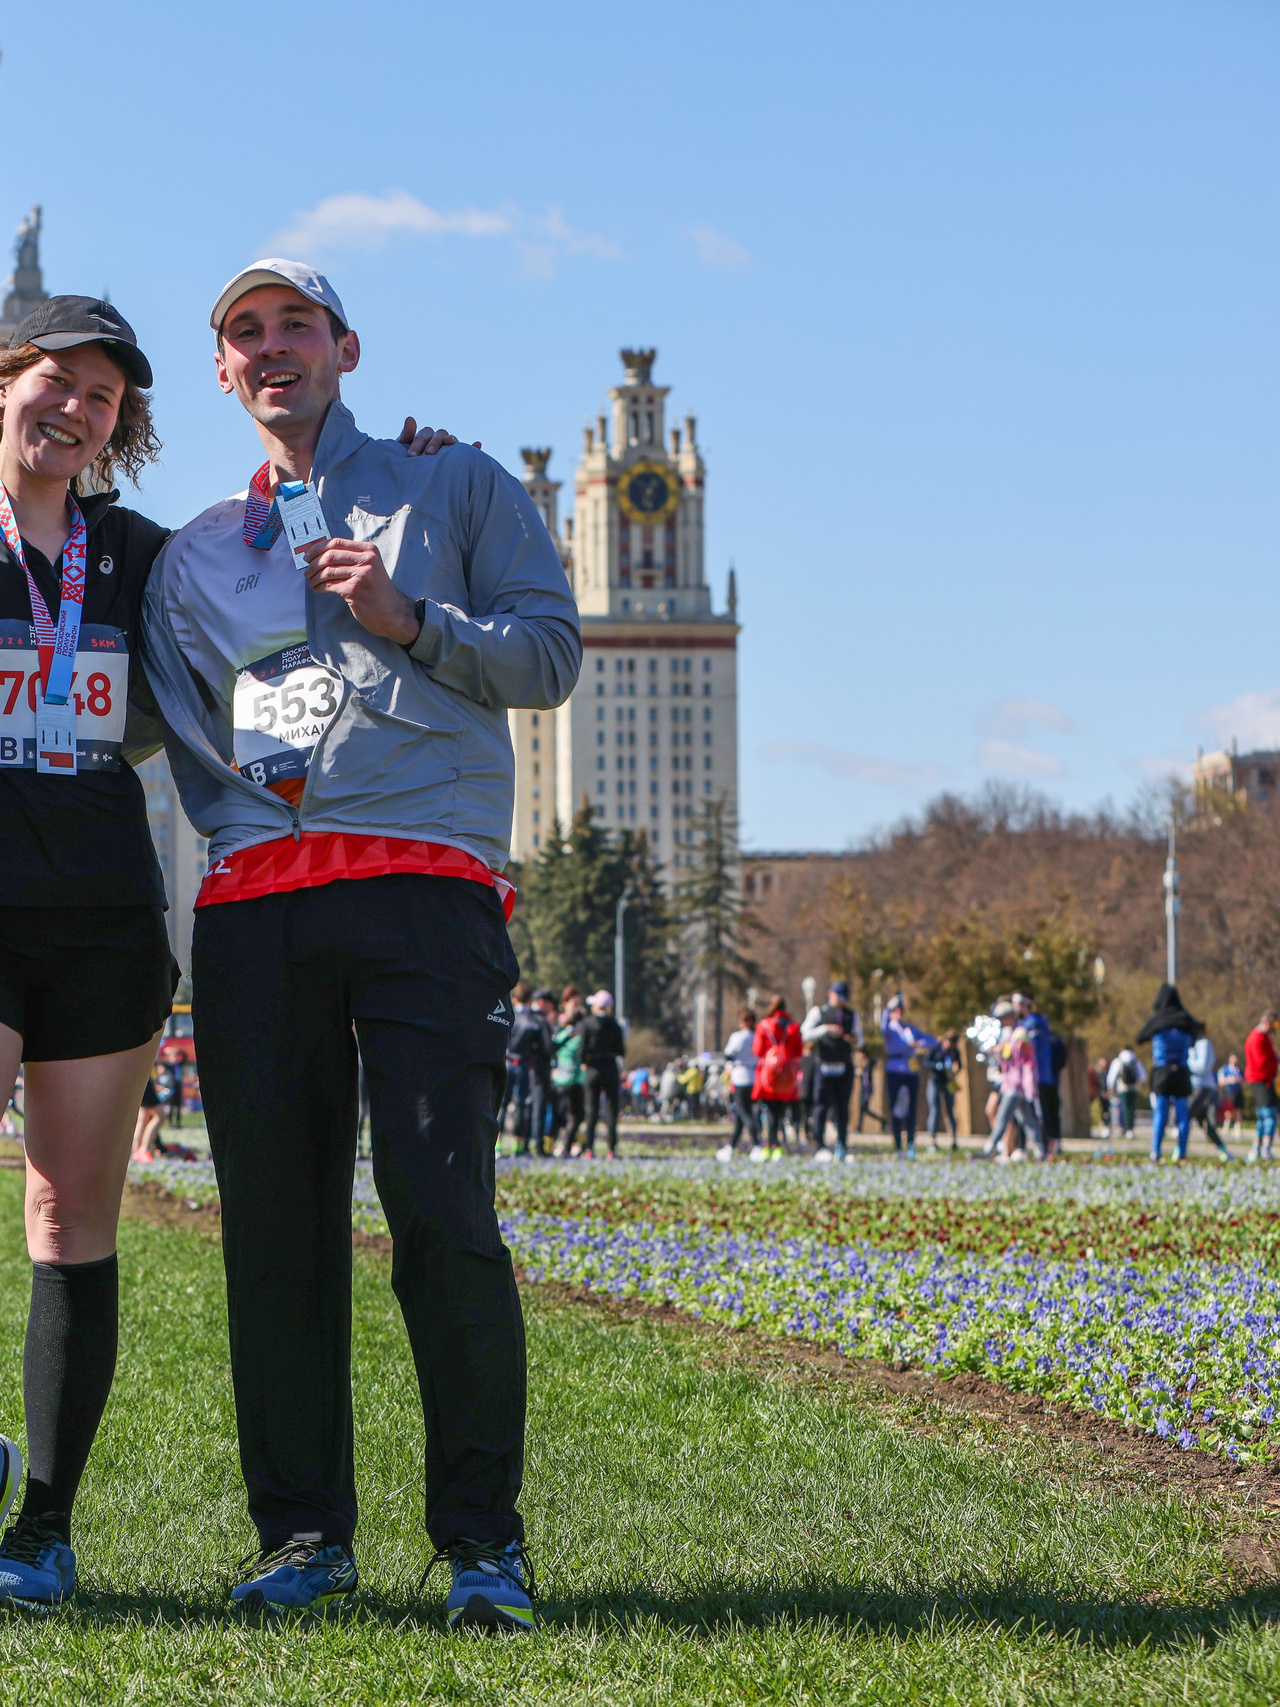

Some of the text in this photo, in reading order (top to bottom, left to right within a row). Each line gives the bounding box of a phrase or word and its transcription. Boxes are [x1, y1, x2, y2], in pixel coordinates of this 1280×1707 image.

[56, 610, 67, 655] МОСКОВСКИЙ
[68, 625, 78, 657] МАРАФОН
[282, 645, 309, 658] МОСКО
[282, 656, 312, 670] МАРАФО
[253, 676, 337, 734] 553
[278, 723, 325, 743] МИХА
